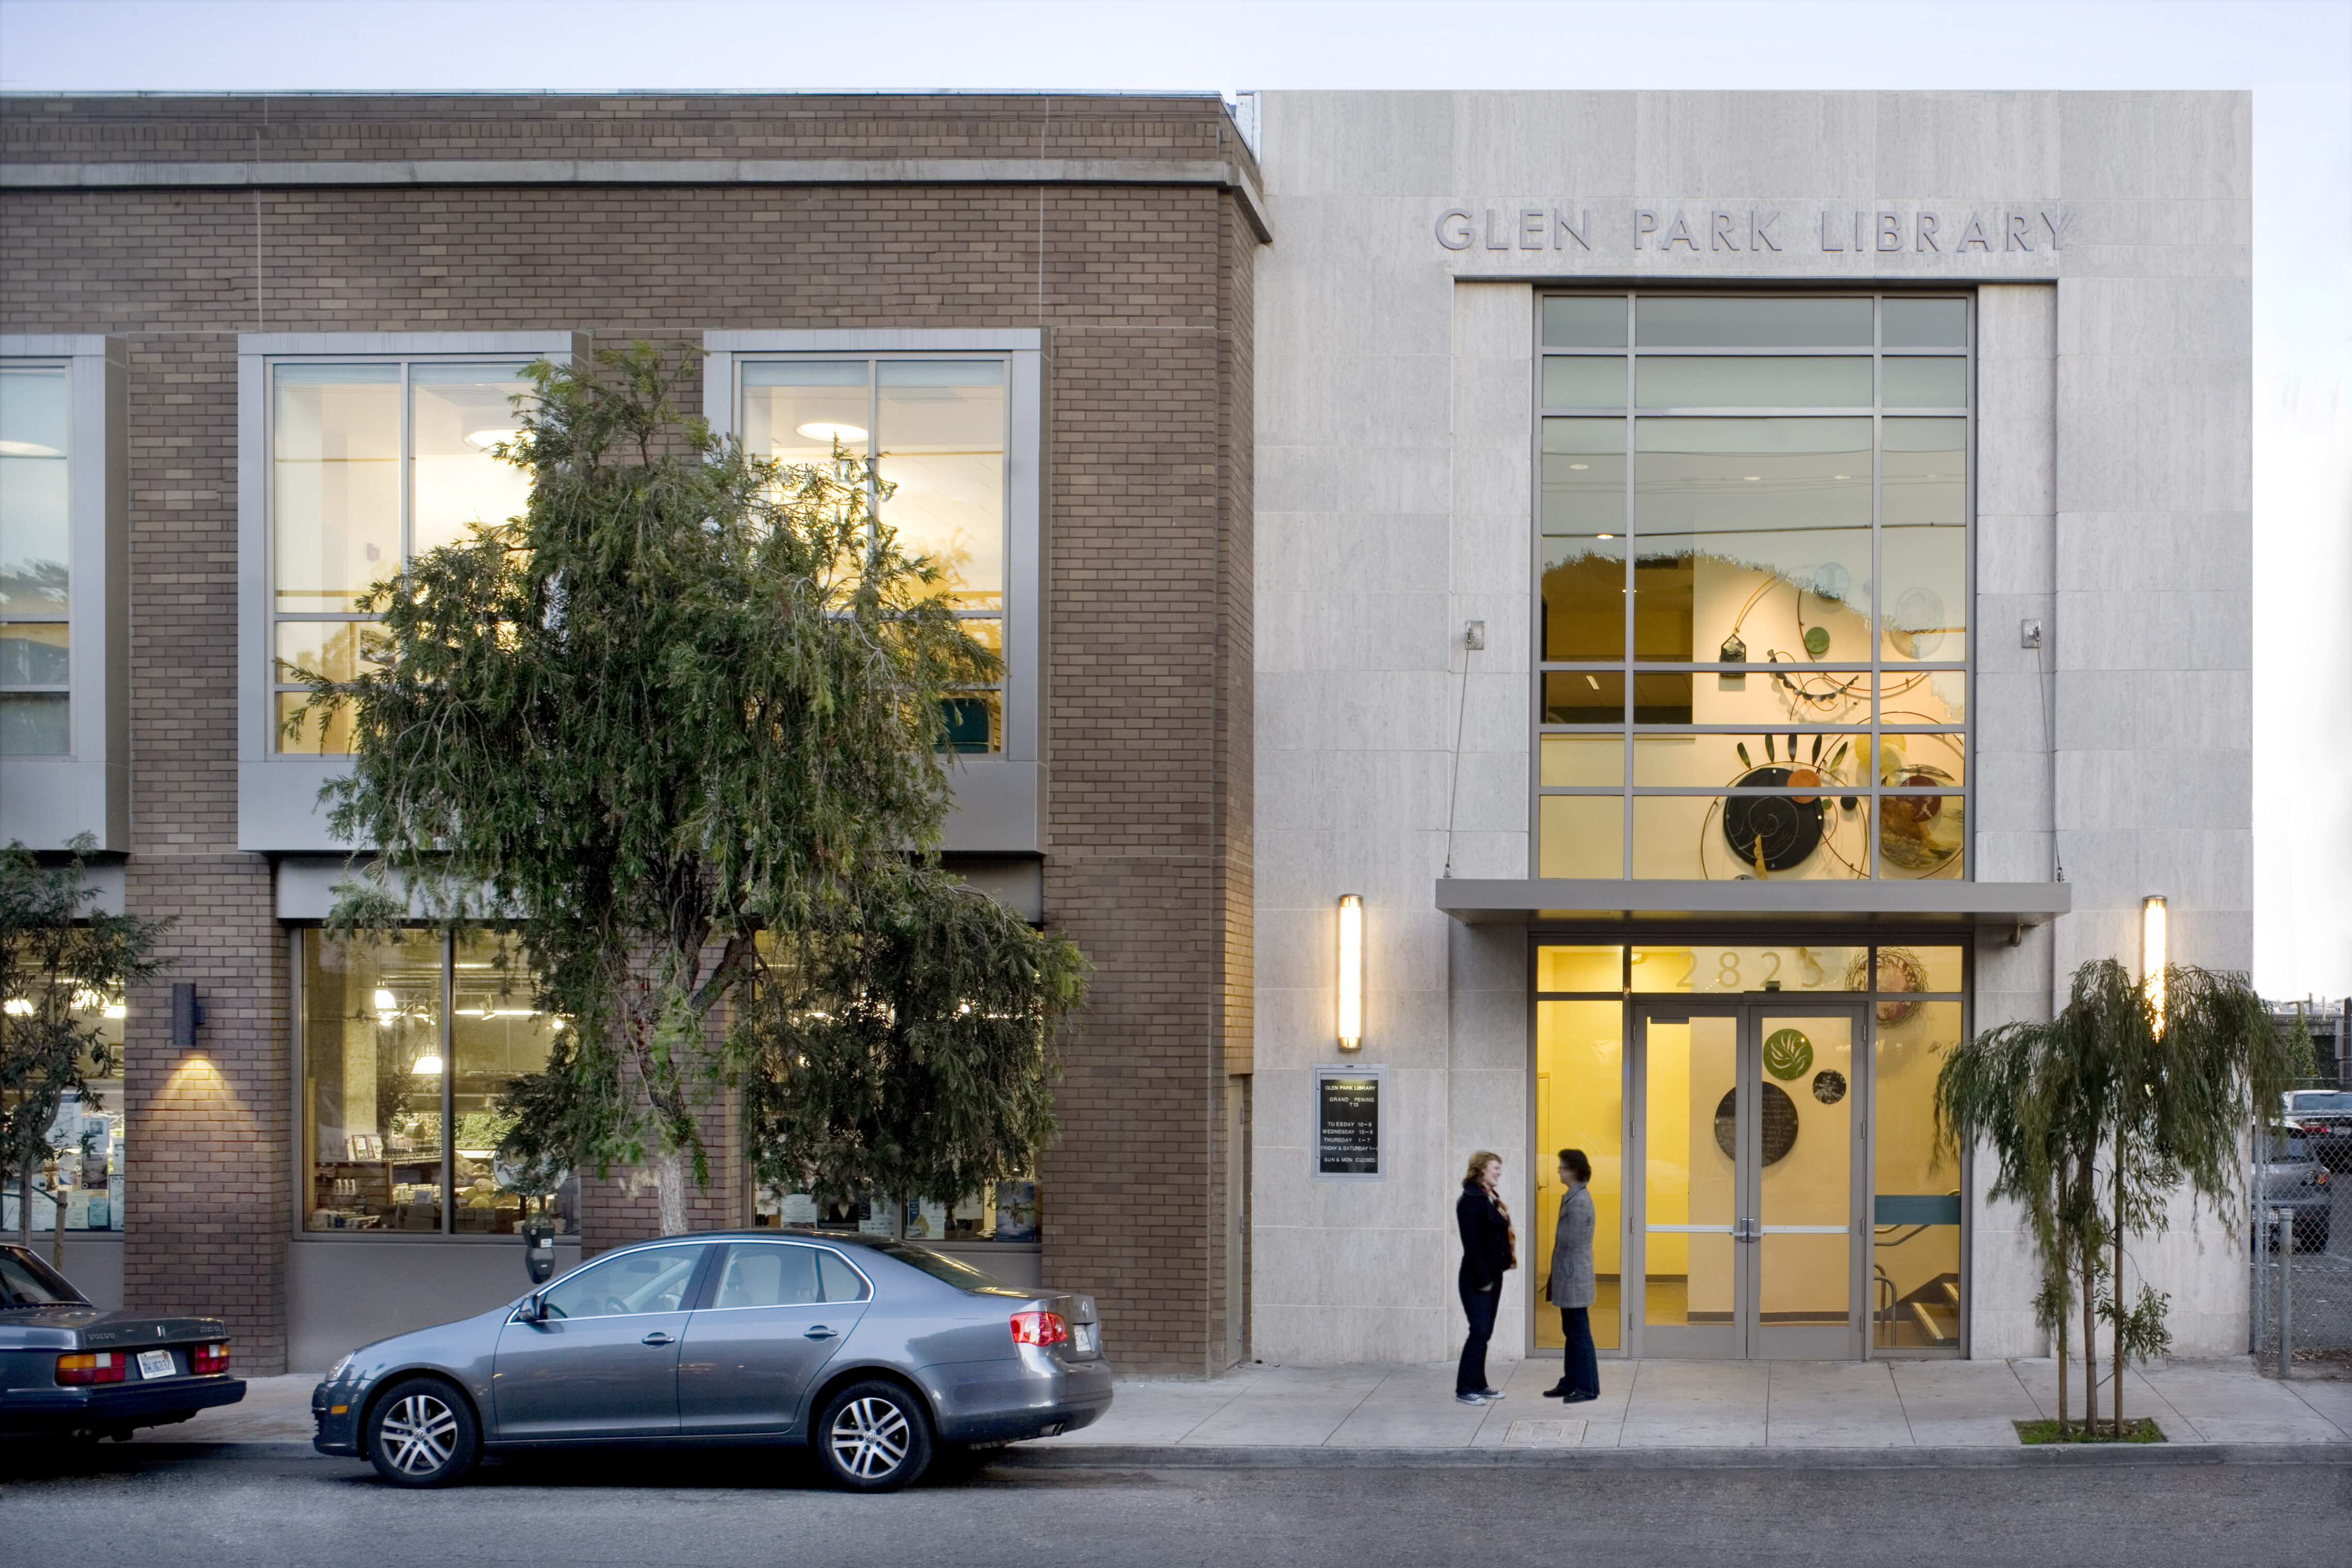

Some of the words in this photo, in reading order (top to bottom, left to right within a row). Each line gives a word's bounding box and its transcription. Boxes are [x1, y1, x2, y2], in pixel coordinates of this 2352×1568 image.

[1435, 207, 1591, 250] GLEN
[1635, 208, 1783, 251] PARK
[1822, 210, 2075, 252] LIBRARY
[1675, 951, 1824, 988] 2825
